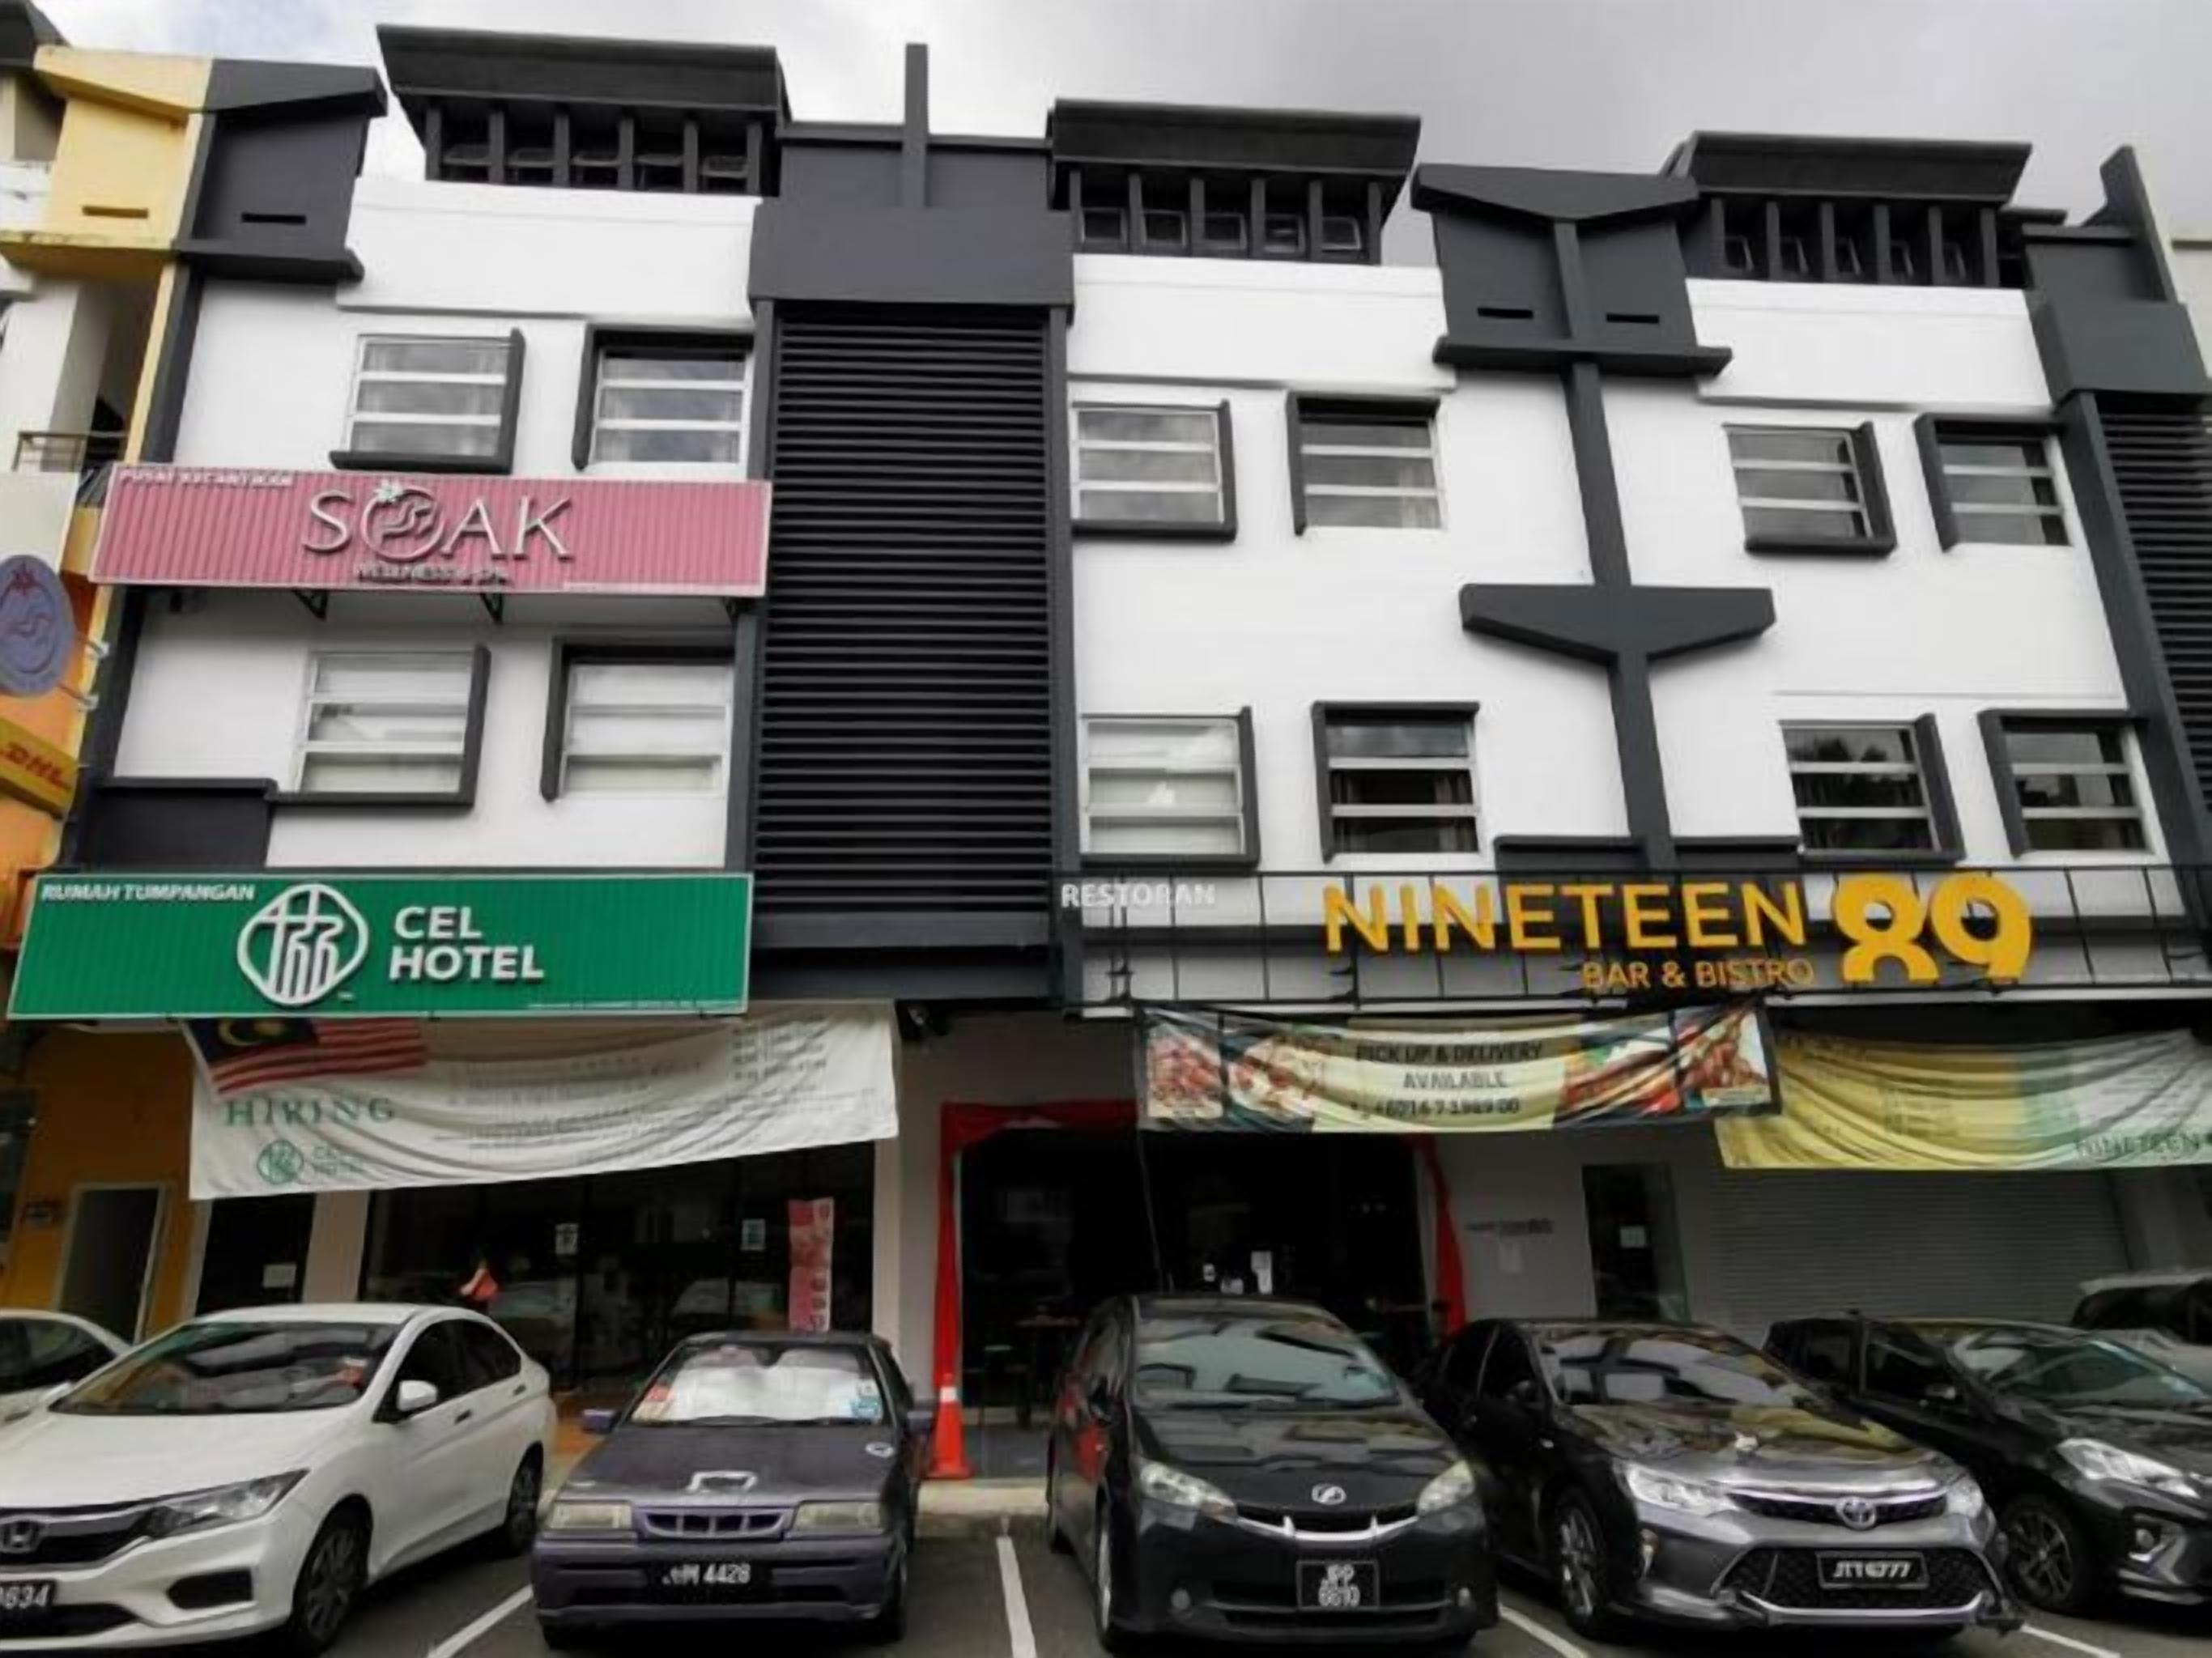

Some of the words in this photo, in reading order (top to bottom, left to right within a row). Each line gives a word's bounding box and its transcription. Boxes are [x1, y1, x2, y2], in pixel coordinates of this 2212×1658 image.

[304, 483, 573, 561] SOAK
[41, 884, 120, 900] RUMAH
[124, 884, 256, 901] TUMPANGAN
[394, 906, 483, 940] CEL
[1061, 882, 1215, 908] RESTORAN
[1323, 881, 1808, 953] NINETEEN
[1832, 873, 2032, 985] 89
[389, 945, 545, 981] HOTEL
[1581, 961, 1649, 989] BAR
[1661, 960, 1685, 988] &
[1695, 958, 1815, 988] BISTRO
[1356, 1044, 1400, 1063] PICK
[1403, 1071, 1509, 1088] AVAILABLE
[226, 1097, 395, 1127] HIRING
[0, 1584, 50, 1609] 634
